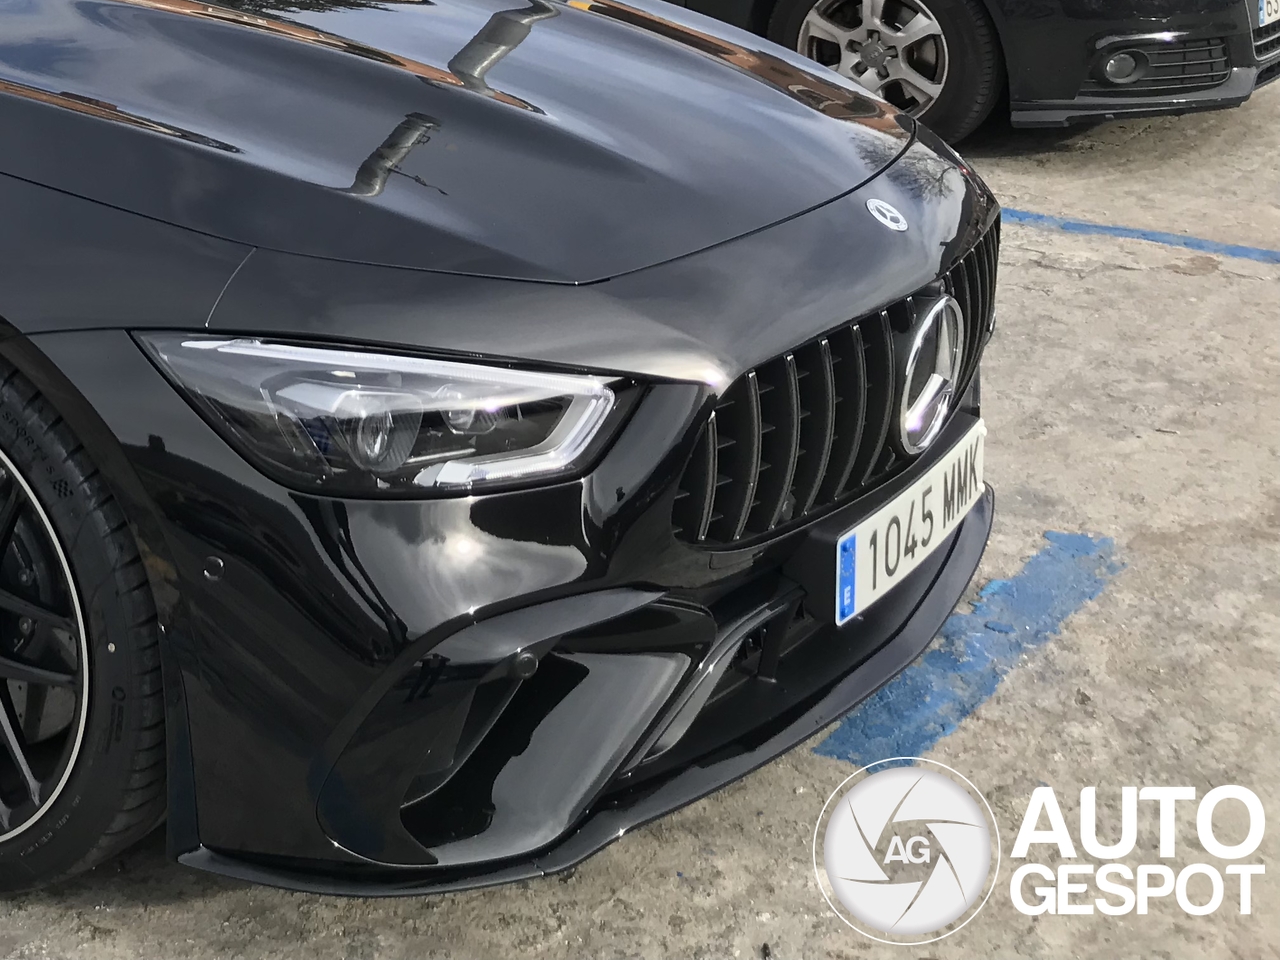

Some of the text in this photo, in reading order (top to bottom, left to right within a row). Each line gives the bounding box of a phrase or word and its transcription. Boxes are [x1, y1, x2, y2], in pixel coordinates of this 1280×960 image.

[870, 434, 979, 591] 1045 MMK
[843, 585, 851, 606] E
